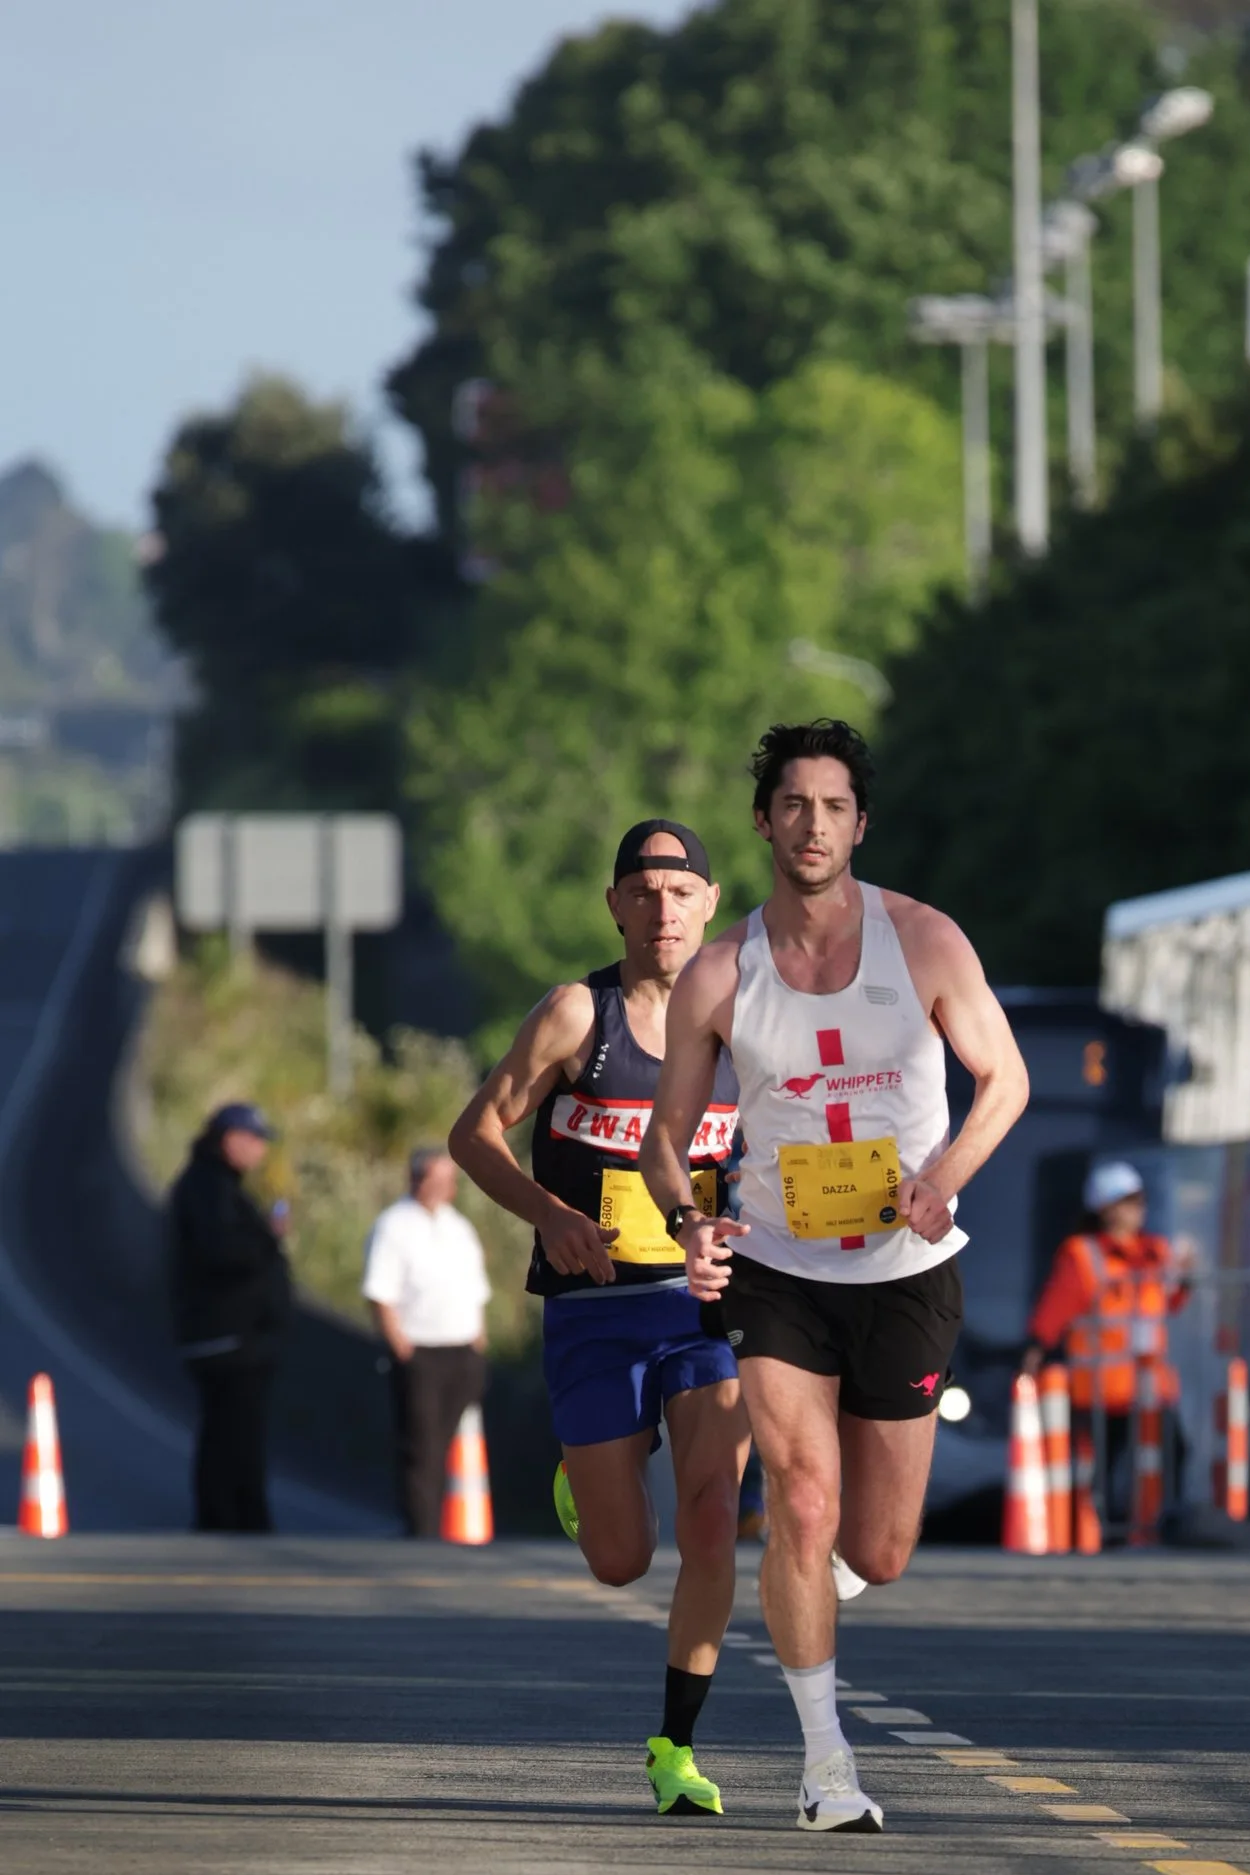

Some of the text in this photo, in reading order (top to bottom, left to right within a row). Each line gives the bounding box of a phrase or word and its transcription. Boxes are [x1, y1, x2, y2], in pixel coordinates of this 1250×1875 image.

[826, 1070, 903, 1091] WHIPPETS
[783, 1176, 796, 1208] 4016
[822, 1184, 857, 1195] DAZZA
[885, 1168, 898, 1198] 4016
[601, 1196, 613, 1230] 5800
